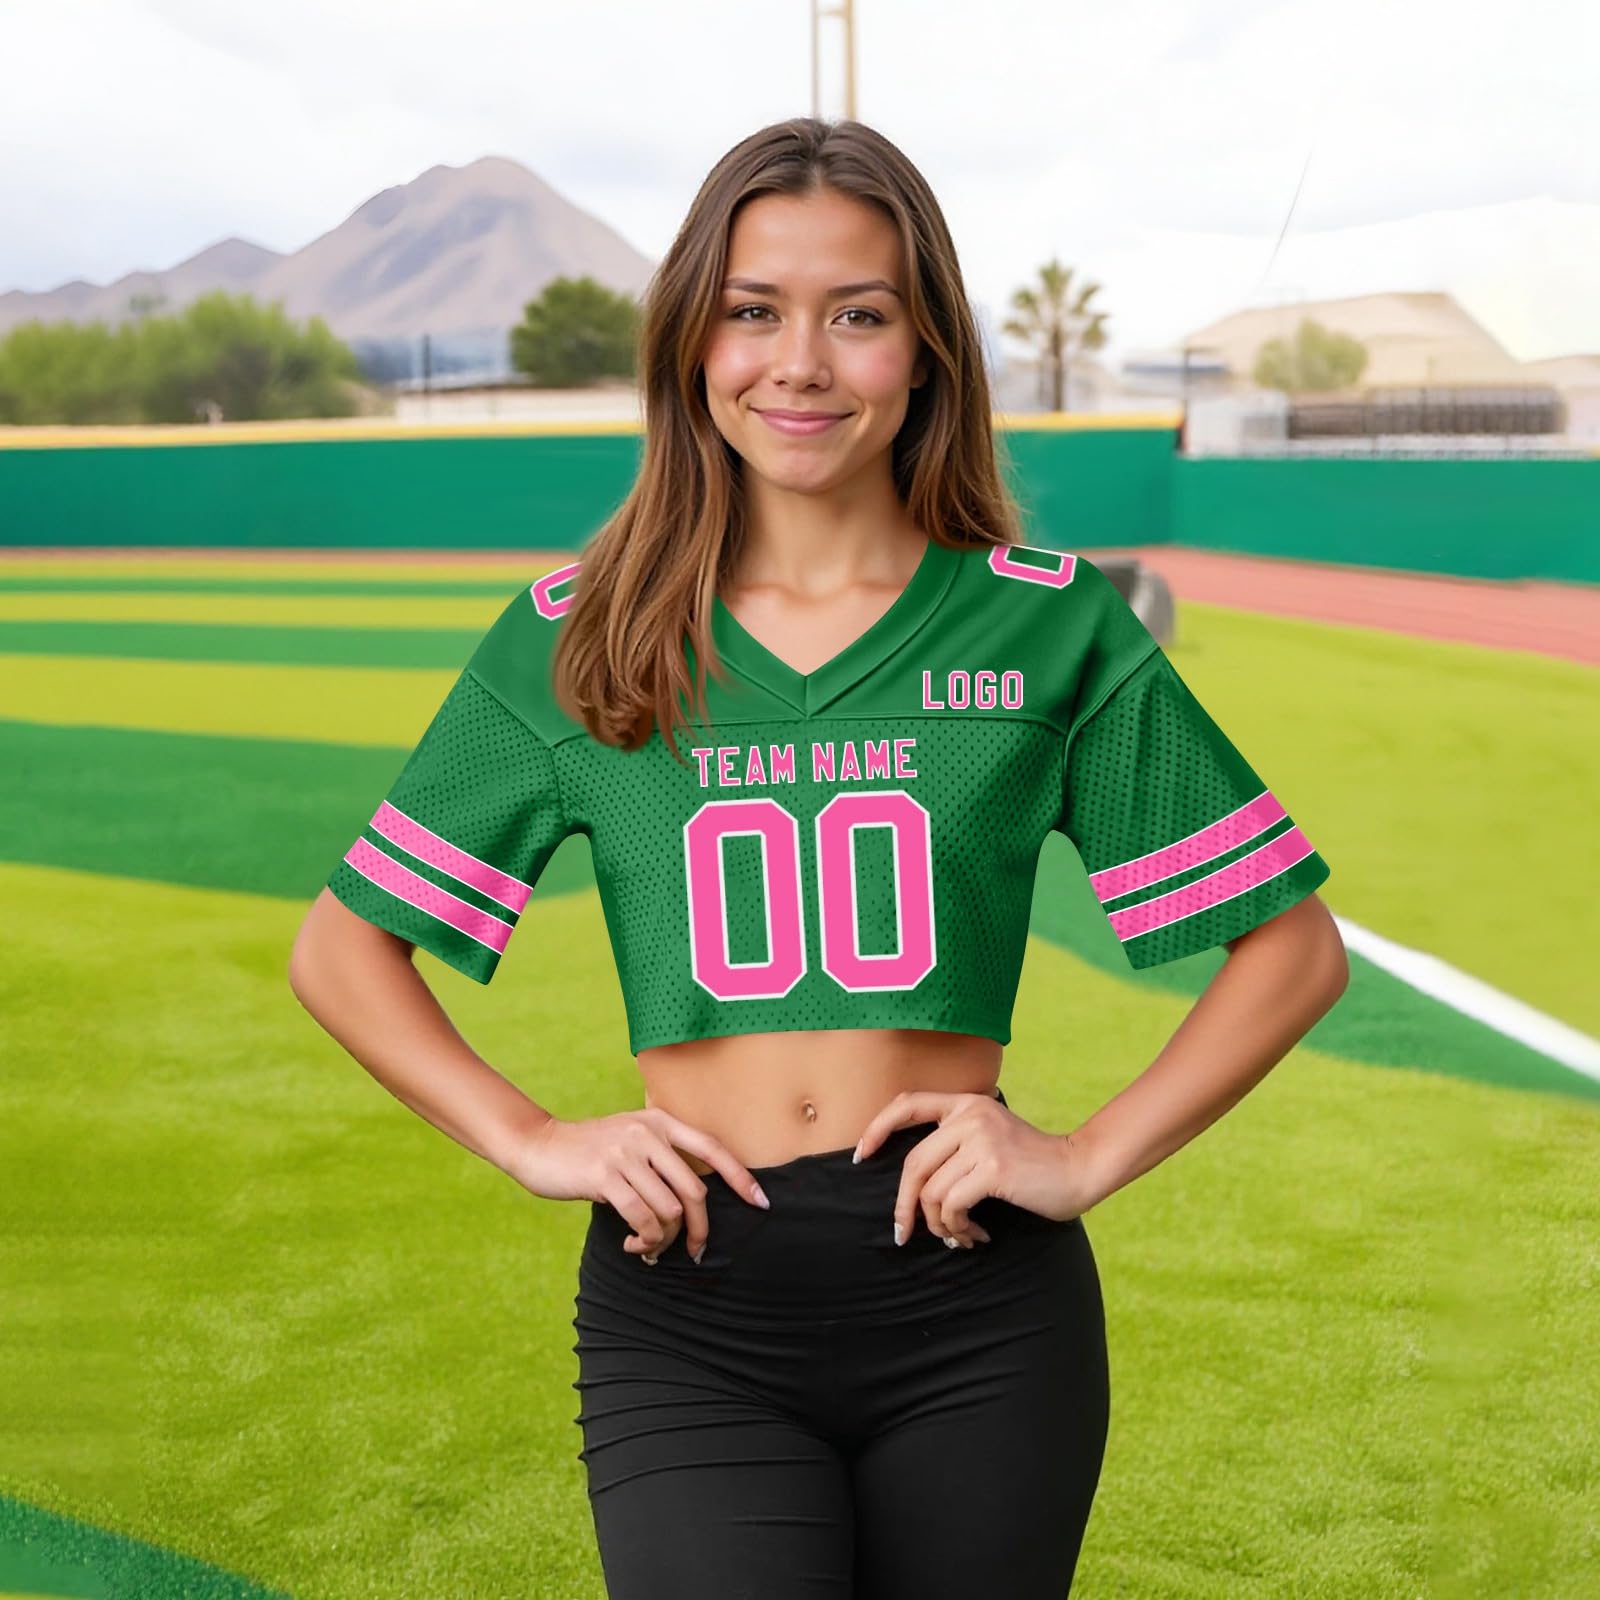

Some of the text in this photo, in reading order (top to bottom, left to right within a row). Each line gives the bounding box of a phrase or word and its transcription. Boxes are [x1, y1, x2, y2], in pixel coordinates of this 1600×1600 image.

[922, 670, 1024, 710] LOGO
[691, 738, 919, 788] TEAM NAME
[684, 791, 937, 1001] 00
